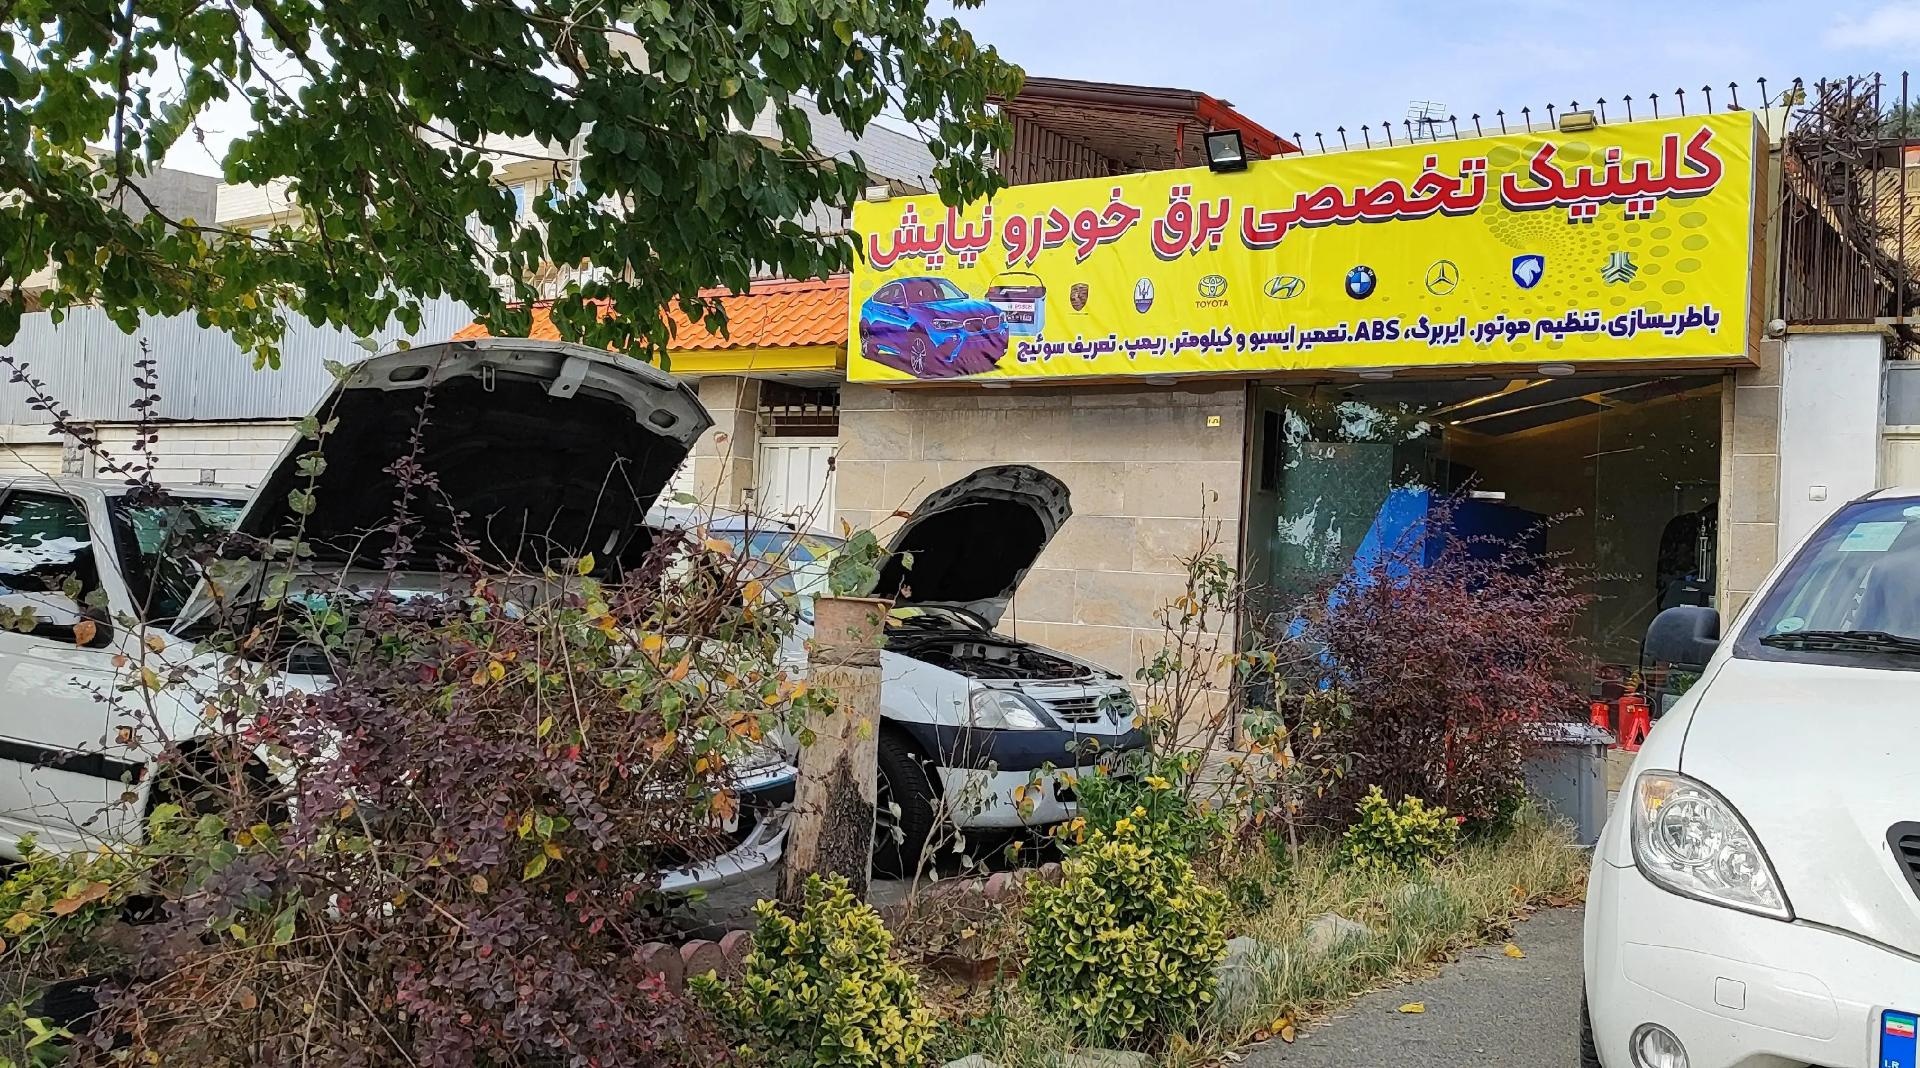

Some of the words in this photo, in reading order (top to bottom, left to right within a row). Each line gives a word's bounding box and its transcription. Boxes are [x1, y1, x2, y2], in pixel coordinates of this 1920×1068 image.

[1241, 155, 1487, 244] تخصصی
[1502, 127, 1724, 217] کلینیک
[869, 204, 992, 267] نیایش
[1004, 187, 1141, 261] خودرو
[1152, 185, 1230, 254] برق
[1195, 299, 1229, 309] TOYOTA
[1236, 333, 1246, 352] و
